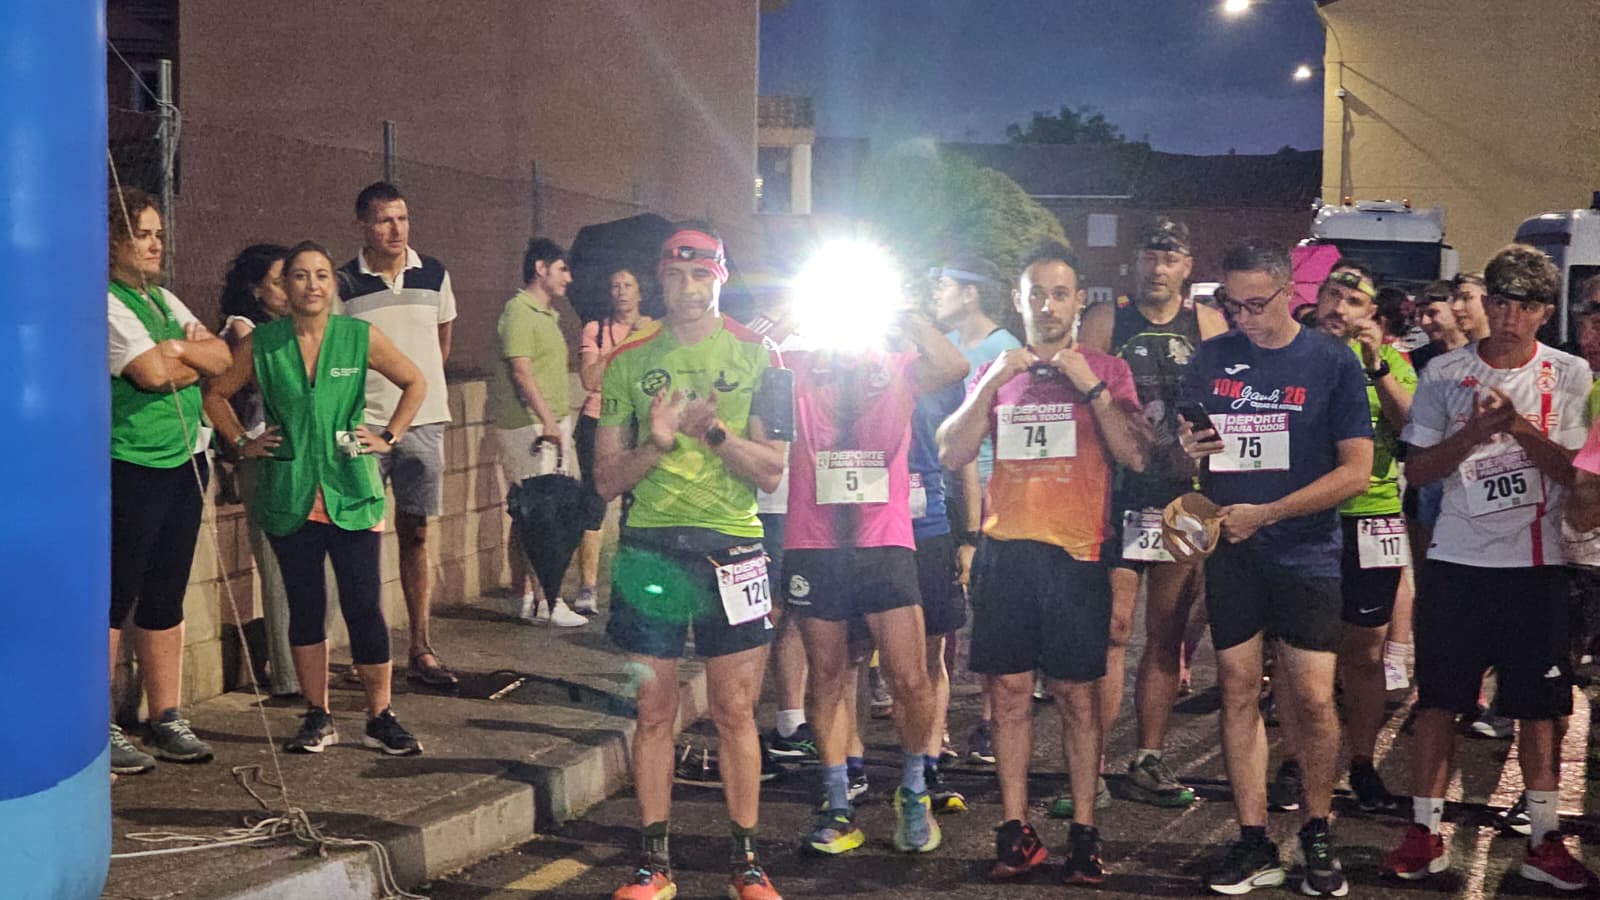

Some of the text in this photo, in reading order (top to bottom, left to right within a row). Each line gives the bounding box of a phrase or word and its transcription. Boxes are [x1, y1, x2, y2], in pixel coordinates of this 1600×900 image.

[1012, 403, 1073, 414] DEPORTE
[1038, 412, 1073, 421] TODOS
[1226, 413, 1287, 425] DEPORTE
[1226, 423, 1286, 433] PARA TODOS
[1023, 425, 1048, 448] 74
[1237, 436, 1262, 459] 75
[830, 450, 885, 461] DEPORTE
[845, 470, 859, 492] 5
[1483, 472, 1527, 502] 205
[1379, 537, 1400, 556] 117
